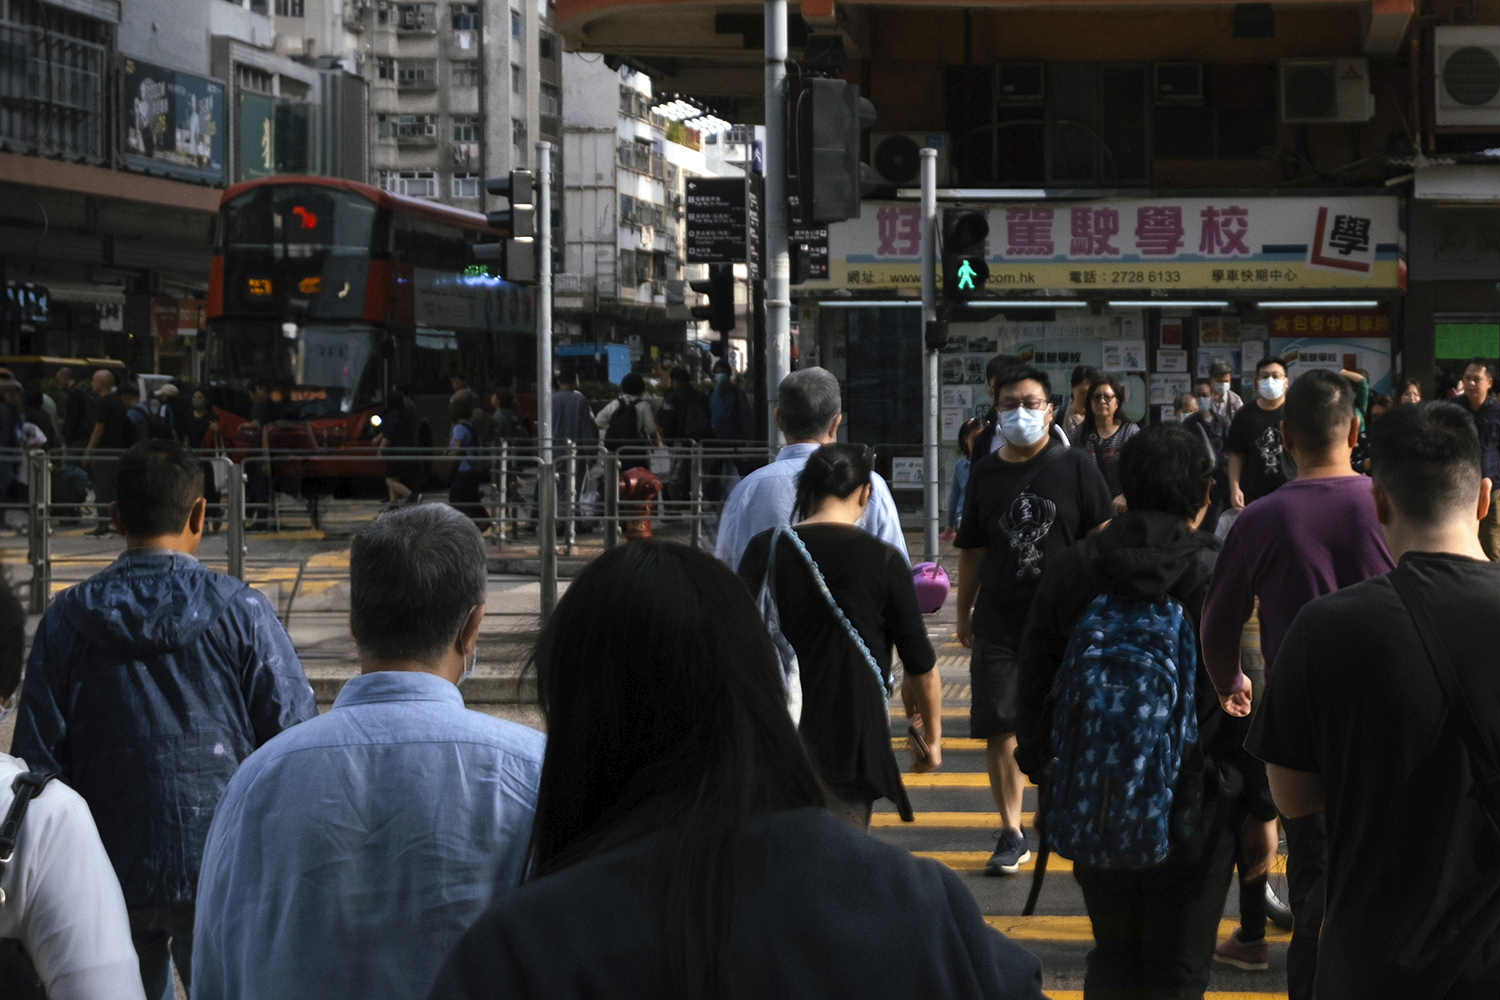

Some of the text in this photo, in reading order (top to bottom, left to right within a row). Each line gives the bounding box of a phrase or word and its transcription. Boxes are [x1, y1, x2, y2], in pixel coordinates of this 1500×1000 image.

[876, 206, 1250, 256] 好駕駛學校
[1329, 214, 1371, 256] 學
[1112, 271, 1144, 283] 2728
[1148, 271, 1181, 283] 6133
